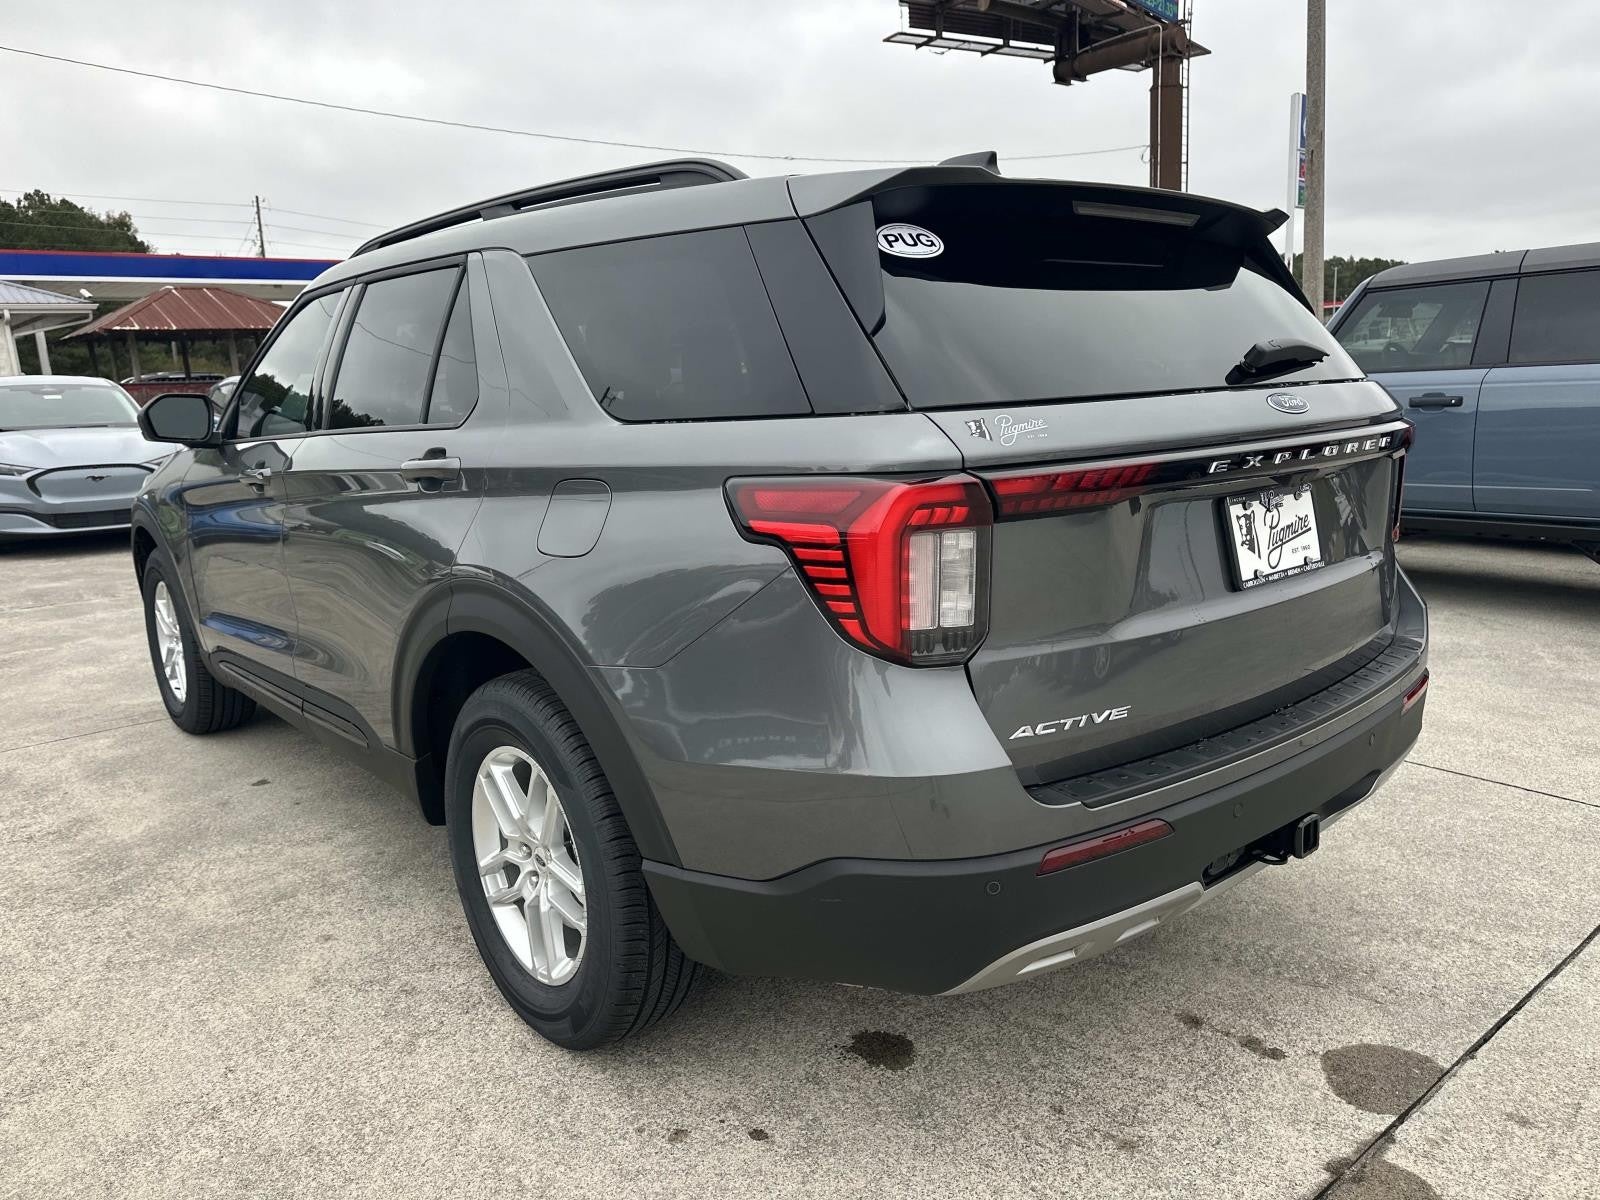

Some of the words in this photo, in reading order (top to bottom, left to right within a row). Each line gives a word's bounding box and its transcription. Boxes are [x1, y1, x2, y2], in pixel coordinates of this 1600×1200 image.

[882, 232, 937, 248] PUG
[994, 414, 1048, 446] Pugmire
[1208, 436, 1392, 474] EXPLORER
[1263, 508, 1312, 569] Pugmire
[1008, 705, 1132, 740] ACTIVE
